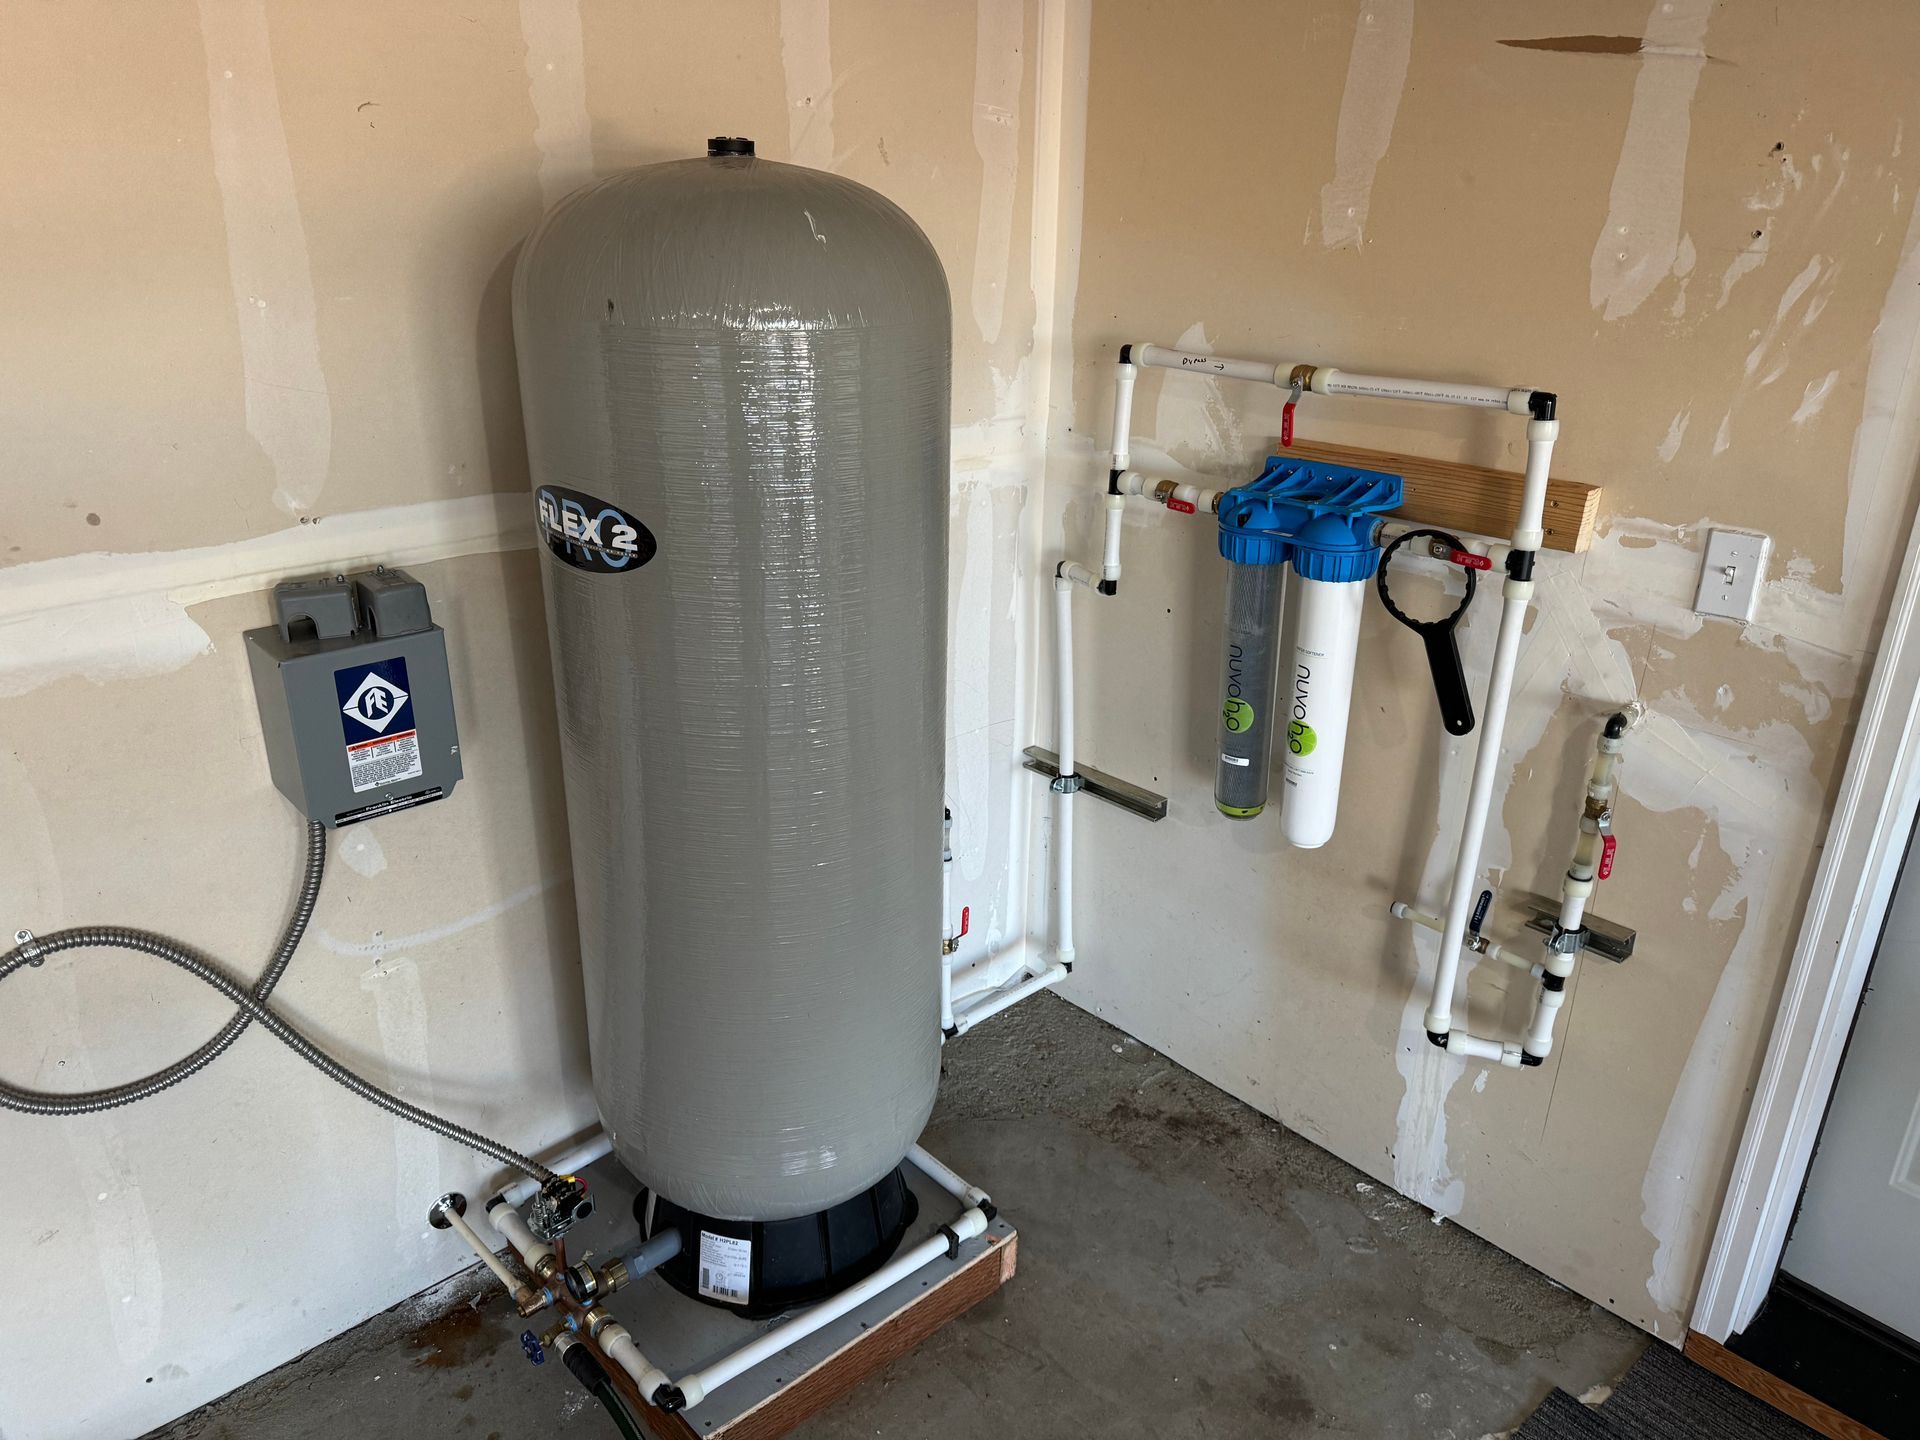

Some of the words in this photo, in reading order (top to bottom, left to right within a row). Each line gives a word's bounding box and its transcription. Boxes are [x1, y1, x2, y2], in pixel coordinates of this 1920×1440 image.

[538, 498, 603, 545] FLEX
[611, 524, 638, 552] 2
[365, 801, 389, 811] Franklin
[702, 1232, 714, 1240] Model
